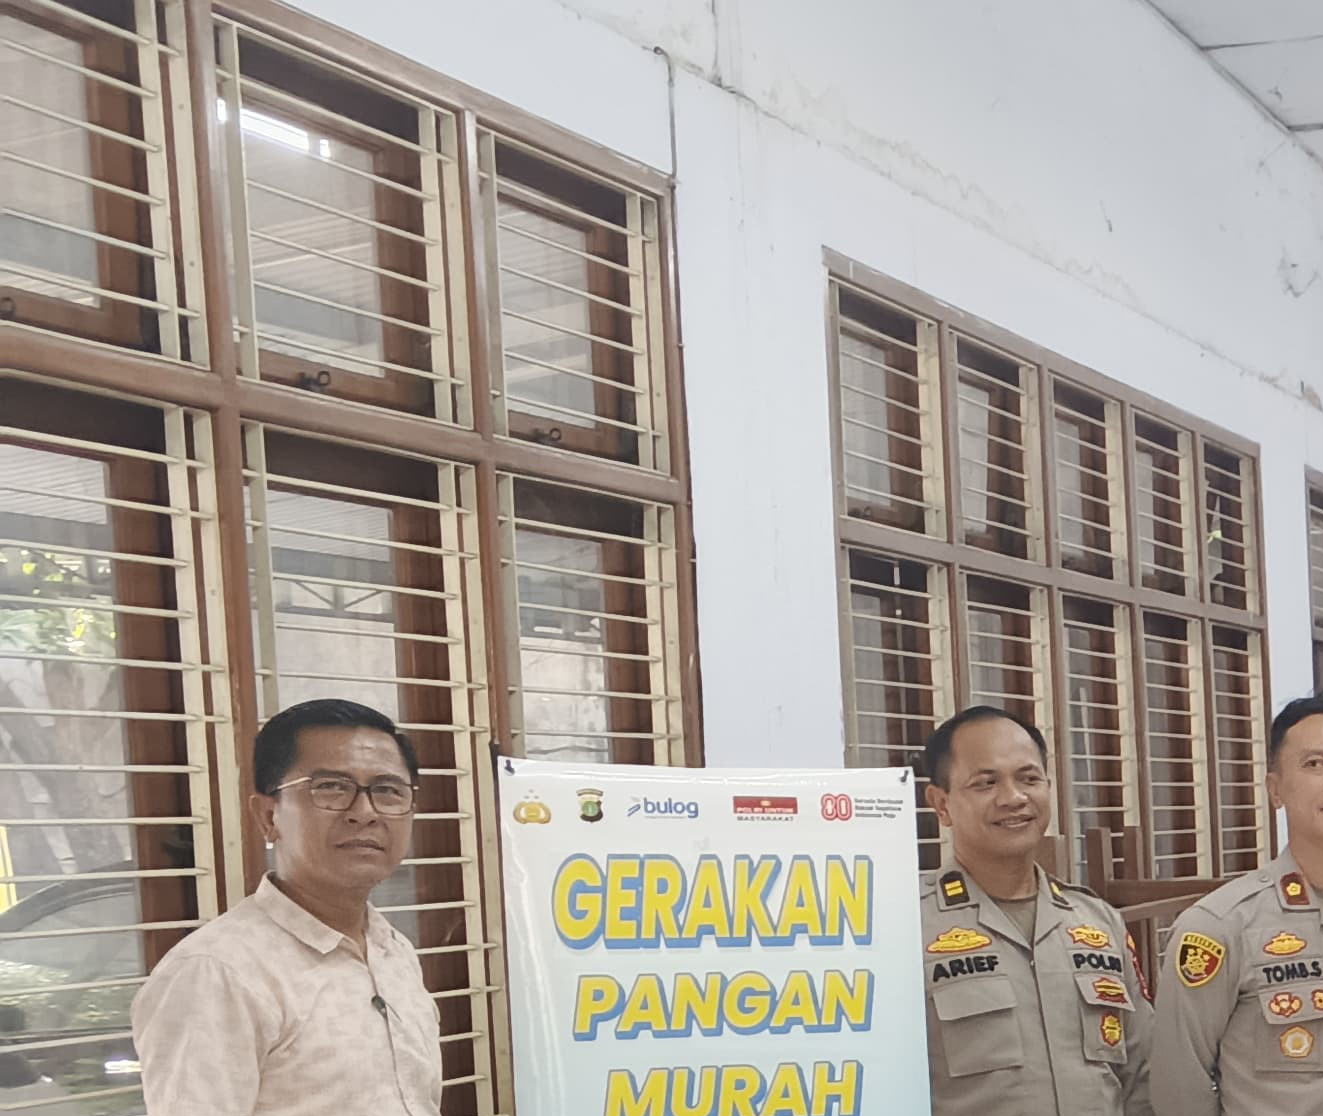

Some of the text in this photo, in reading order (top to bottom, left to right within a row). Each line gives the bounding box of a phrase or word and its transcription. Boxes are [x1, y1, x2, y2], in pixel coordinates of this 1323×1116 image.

[643, 797, 699, 819] bulog
[551, 853, 874, 950] GERAKAN
[932, 955, 1000, 982] ARIEF
[1072, 953, 1122, 973] POLRI
[572, 969, 875, 1042] PANGAN
